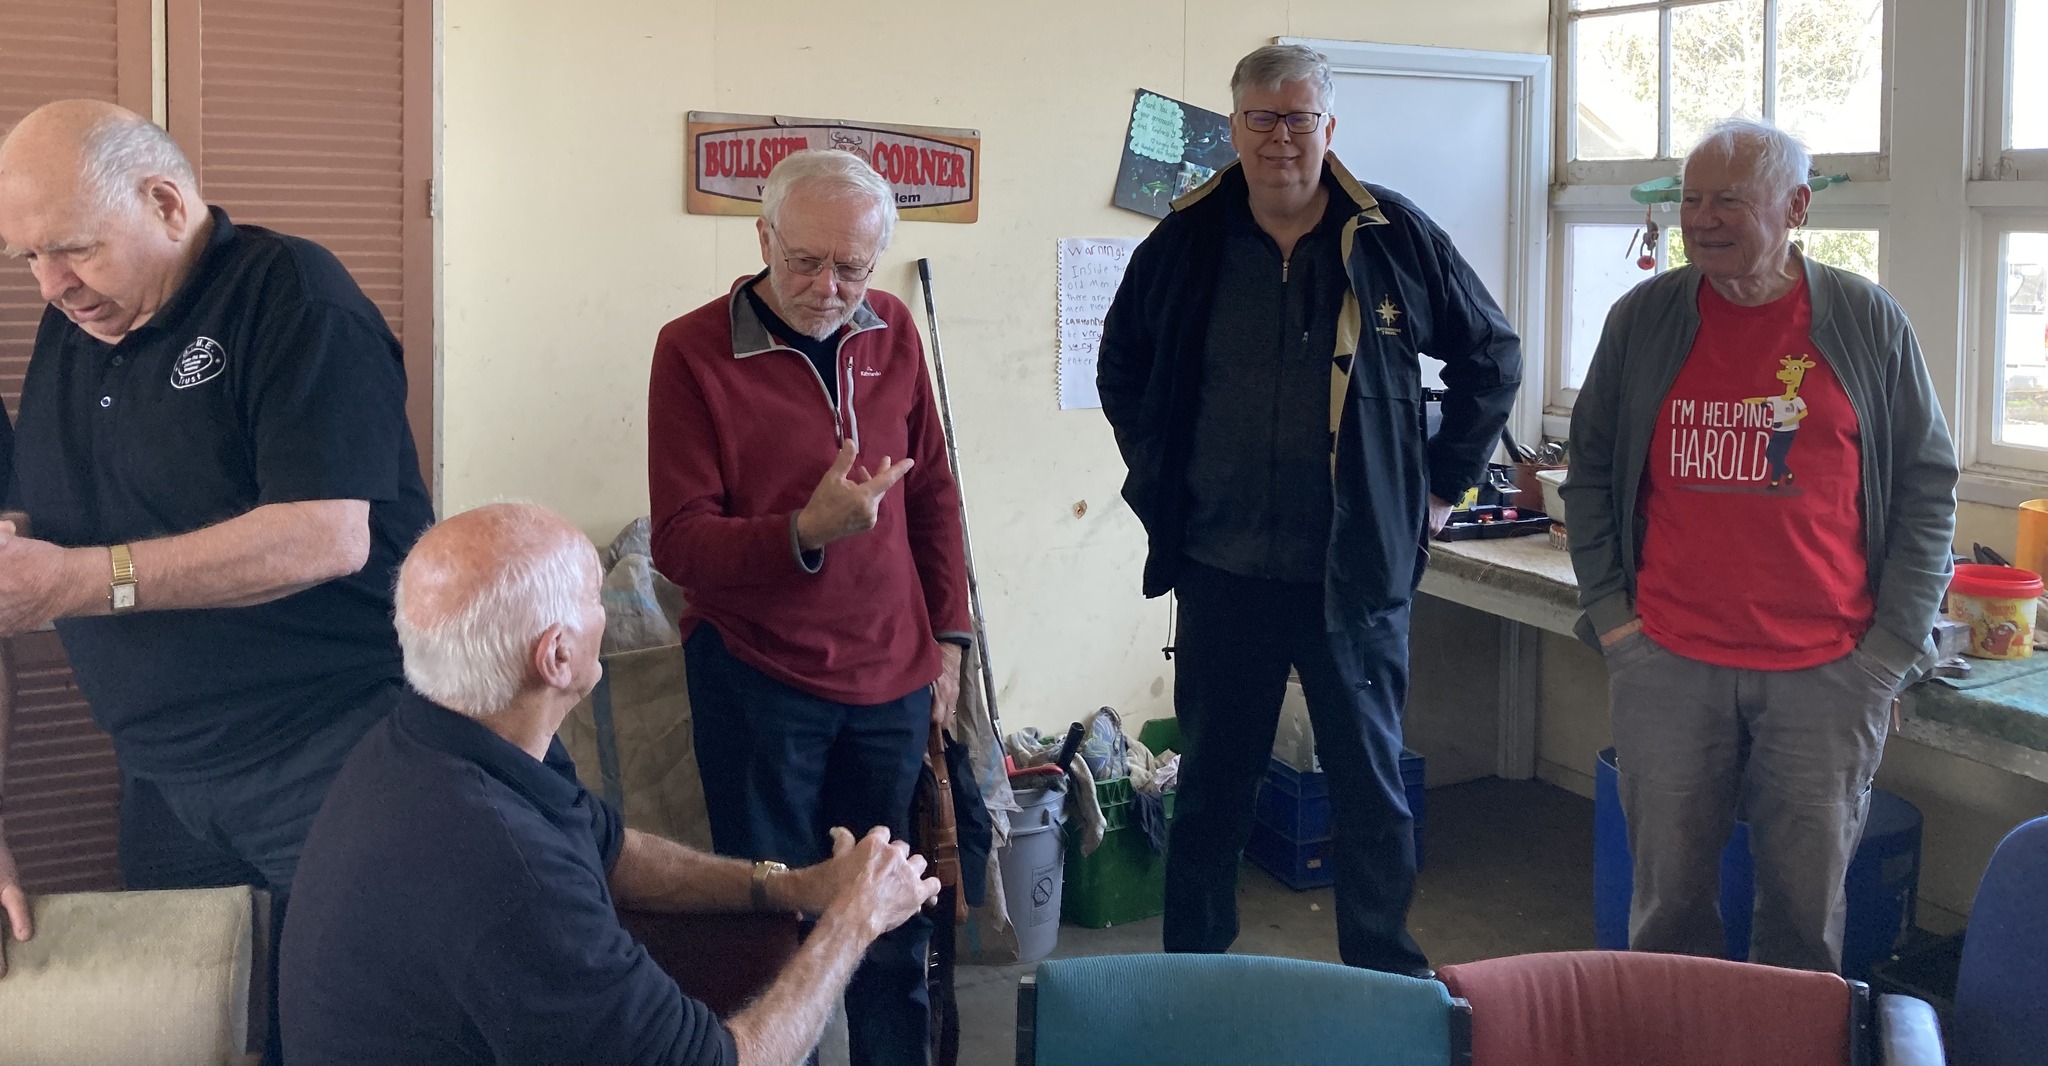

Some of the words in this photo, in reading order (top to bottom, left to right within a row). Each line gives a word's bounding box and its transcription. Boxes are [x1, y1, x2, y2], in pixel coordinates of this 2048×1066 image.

[873, 142, 966, 188] CORNER
[1067, 245, 1125, 261] Warning!
[1065, 293, 1087, 302] there
[1672, 399, 1695, 425] I'M
[1702, 401, 1773, 428] HELPING
[1670, 428, 1770, 481] HAROLD
